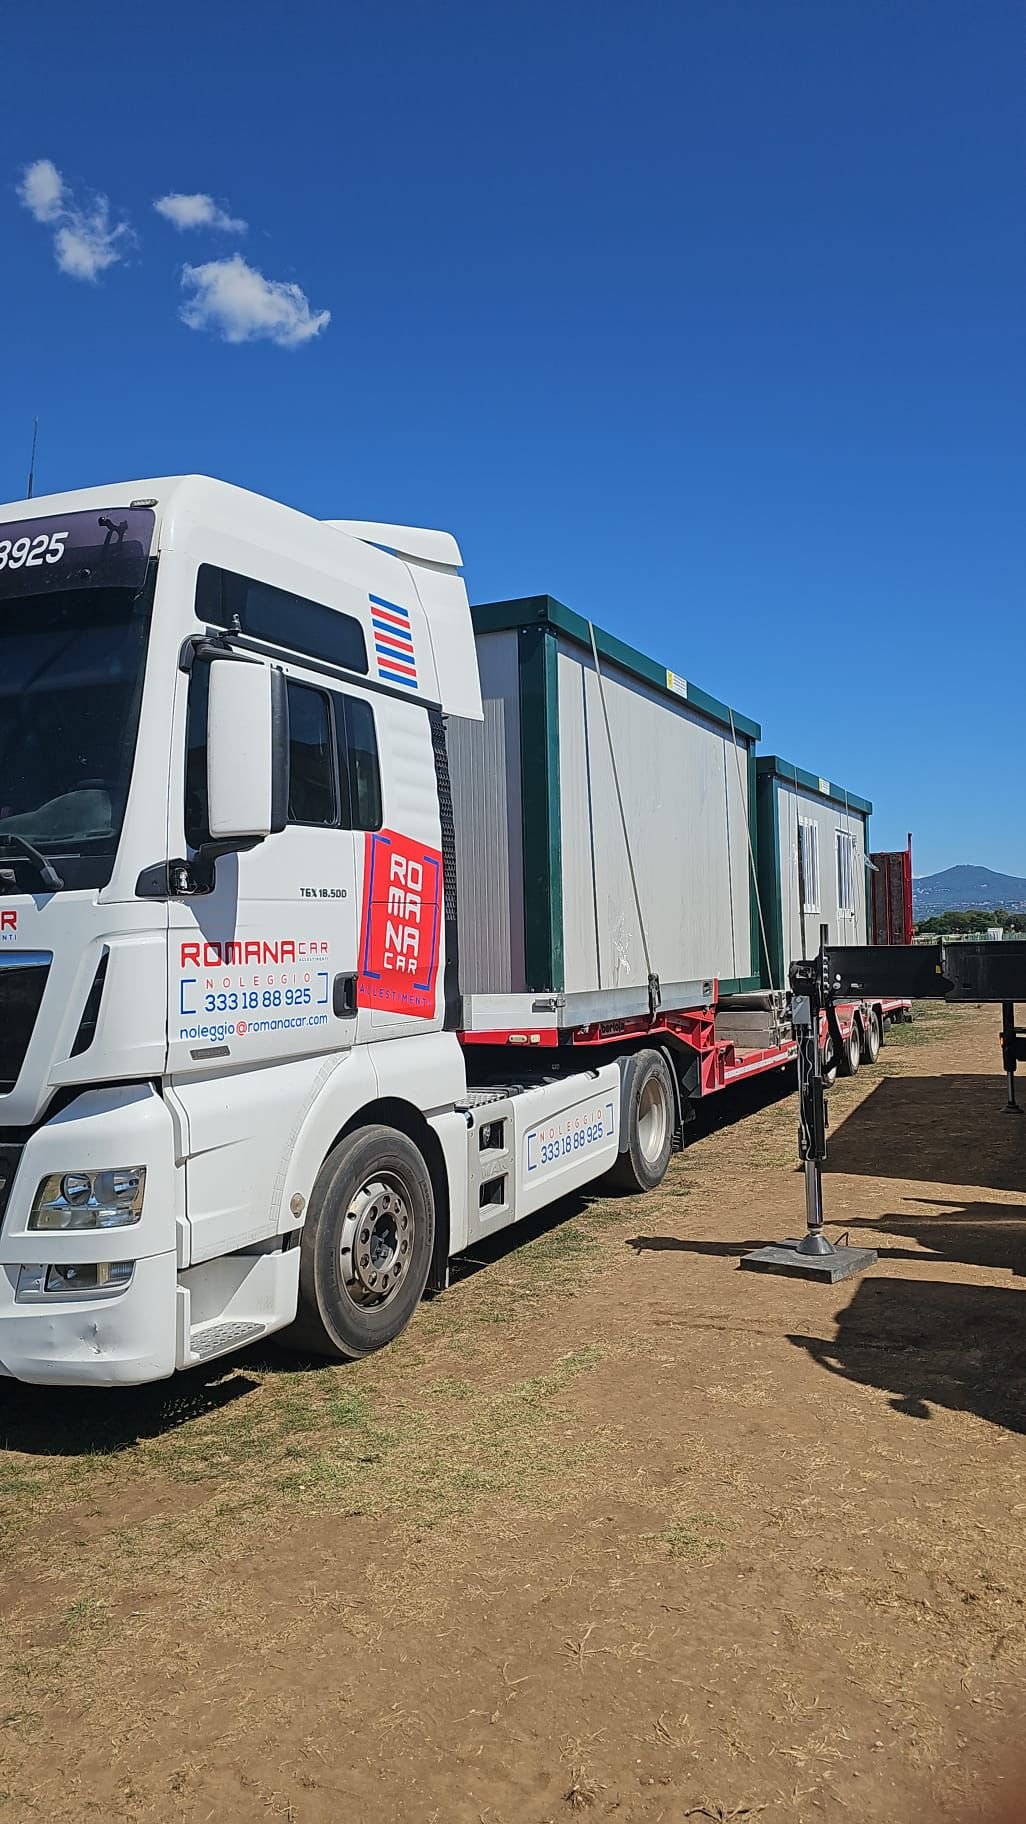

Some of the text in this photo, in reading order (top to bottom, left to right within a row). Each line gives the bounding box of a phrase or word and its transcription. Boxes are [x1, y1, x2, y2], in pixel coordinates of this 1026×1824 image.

[390, 853, 423, 892] RO
[300, 888, 347, 898] TGX 18.500
[387, 886, 421, 923] MA
[385, 920, 420, 958] NA
[181, 941, 329, 968] ROMANA CAR
[383, 952, 418, 975] CAR
[206, 973, 310, 989] NOLEGGIO
[204, 988, 311, 1012] 333 18 88 925
[360, 983, 432, 1008] ALLESTIMENTI
[180, 1014, 328, 1042] noleggio@romanacar.com
[540, 1109, 602, 1142] NOLEGGIO
[541, 1122, 603, 1164] 333 18 88 925
